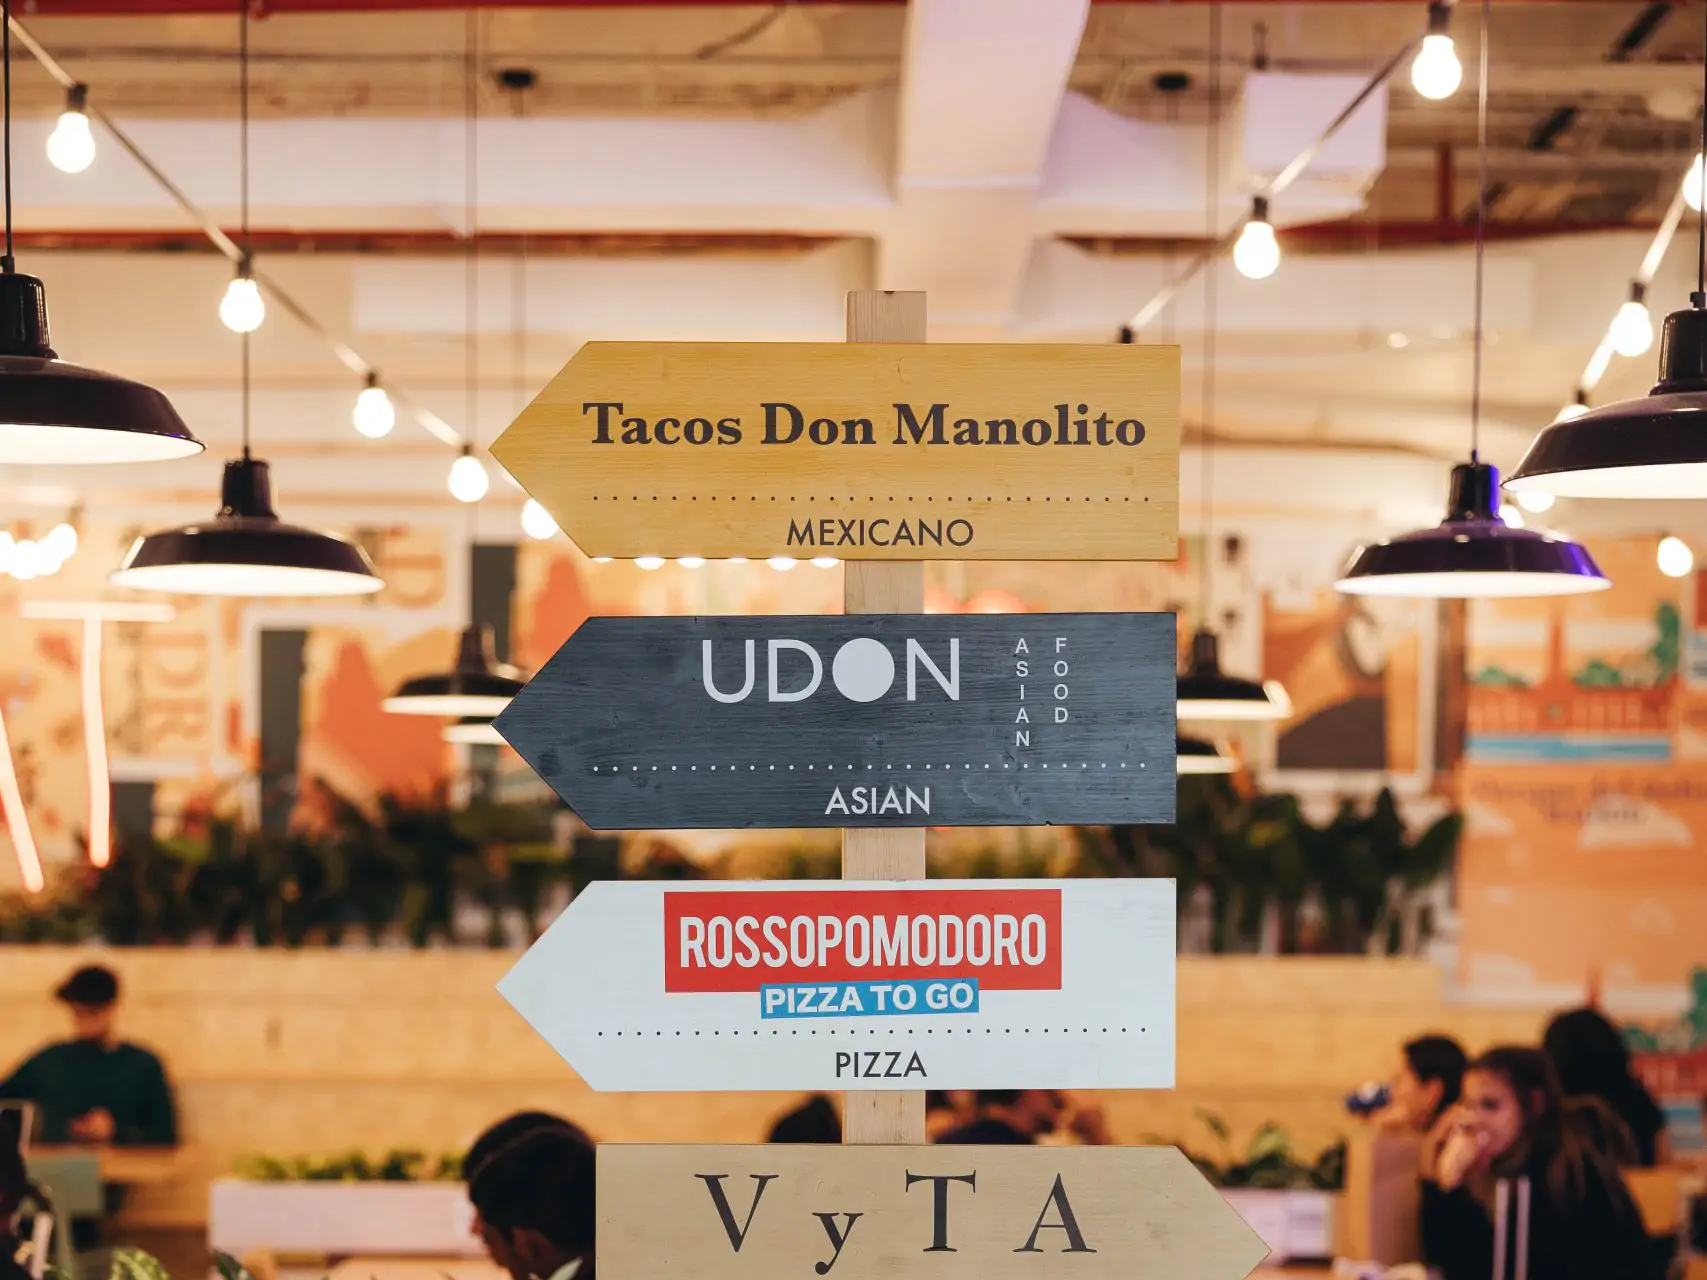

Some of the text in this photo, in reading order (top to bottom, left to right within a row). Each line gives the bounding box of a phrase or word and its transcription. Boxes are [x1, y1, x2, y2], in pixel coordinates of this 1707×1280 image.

[582, 402, 1146, 446] Tacos Don Manolito
[786, 517, 974, 547] MEXICANO
[702, 637, 960, 704] UDON
[1014, 637, 1030, 747] ASIAN
[1053, 637, 1069, 723] FOOD
[824, 785, 930, 815] ASIAN
[680, 913, 1047, 968] ROSSOPOMODORO
[765, 982, 974, 1014] PIZZA TO GO
[835, 1050, 928, 1078] PIZZA
